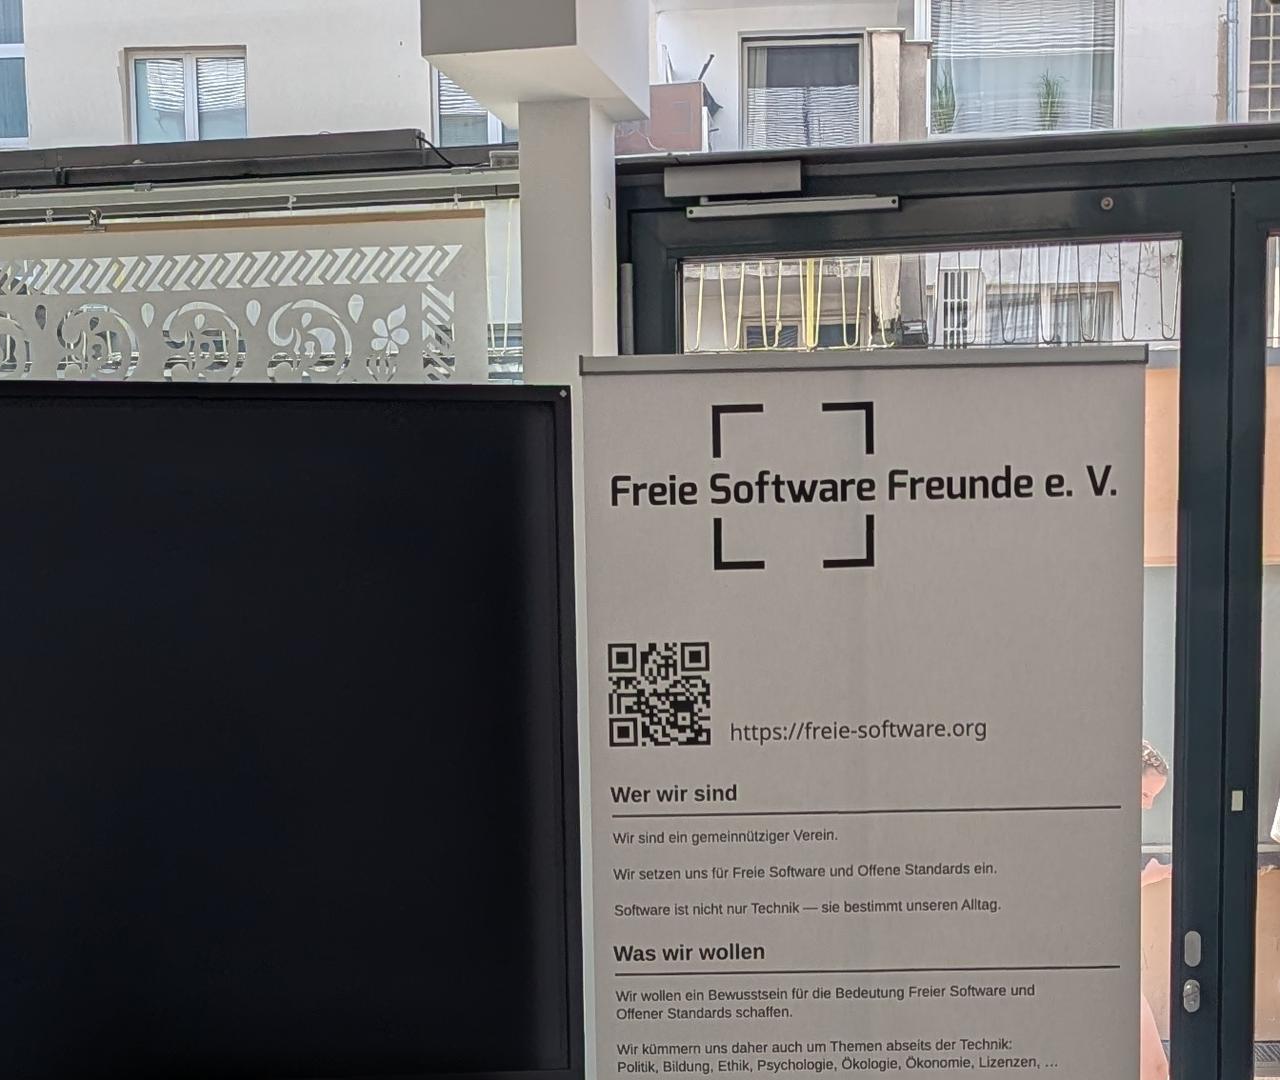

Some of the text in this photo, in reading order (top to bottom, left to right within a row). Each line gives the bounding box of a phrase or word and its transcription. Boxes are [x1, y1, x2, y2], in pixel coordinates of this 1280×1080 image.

[611, 465, 1116, 506] Freie Software Freunde e. V.
[731, 719, 986, 746] https://freie-software.org
[610, 784, 737, 803] Wer wir sind
[613, 828, 837, 845] Wir sind ein gemeinnütziger Verein.
[613, 862, 997, 880] Wir setzen uns für Freie Software und Offene Standards ein.
[614, 903, 670, 916] Software
[675, 903, 689, 916] ist
[691, 902, 723, 915] nicht
[727, 904, 748, 915] nur
[751, 901, 799, 914] Technik
[822, 901, 840, 914] sie
[844, 900, 903, 913] bestimmt
[906, 902, 958, 912] unseren
[961, 899, 1001, 914] Alltag.
[613, 943, 764, 961] Was wir wollen
[616, 983, 1034, 1002] Wir wollen ein Bewusstsein für die Bedeutung Freier Software und
[616, 1005, 792, 1019] Offener Standards schaffen.
[617, 1037, 1012, 1054] Wir kümmern uns daher auch um Themen abseits der Technik:
[618, 1059, 658, 1074] Politik,
[663, 1059, 713, 1074] Bildung,
[718, 1058, 753, 1073] Ethik,
[758, 1058, 837, 1073] Psychologie,
[842, 1054, 901, 1072] Ökologie,
[906, 1053, 974, 1071] Ökonomie,
[979, 1056, 1040, 1071] Lizenzen,
